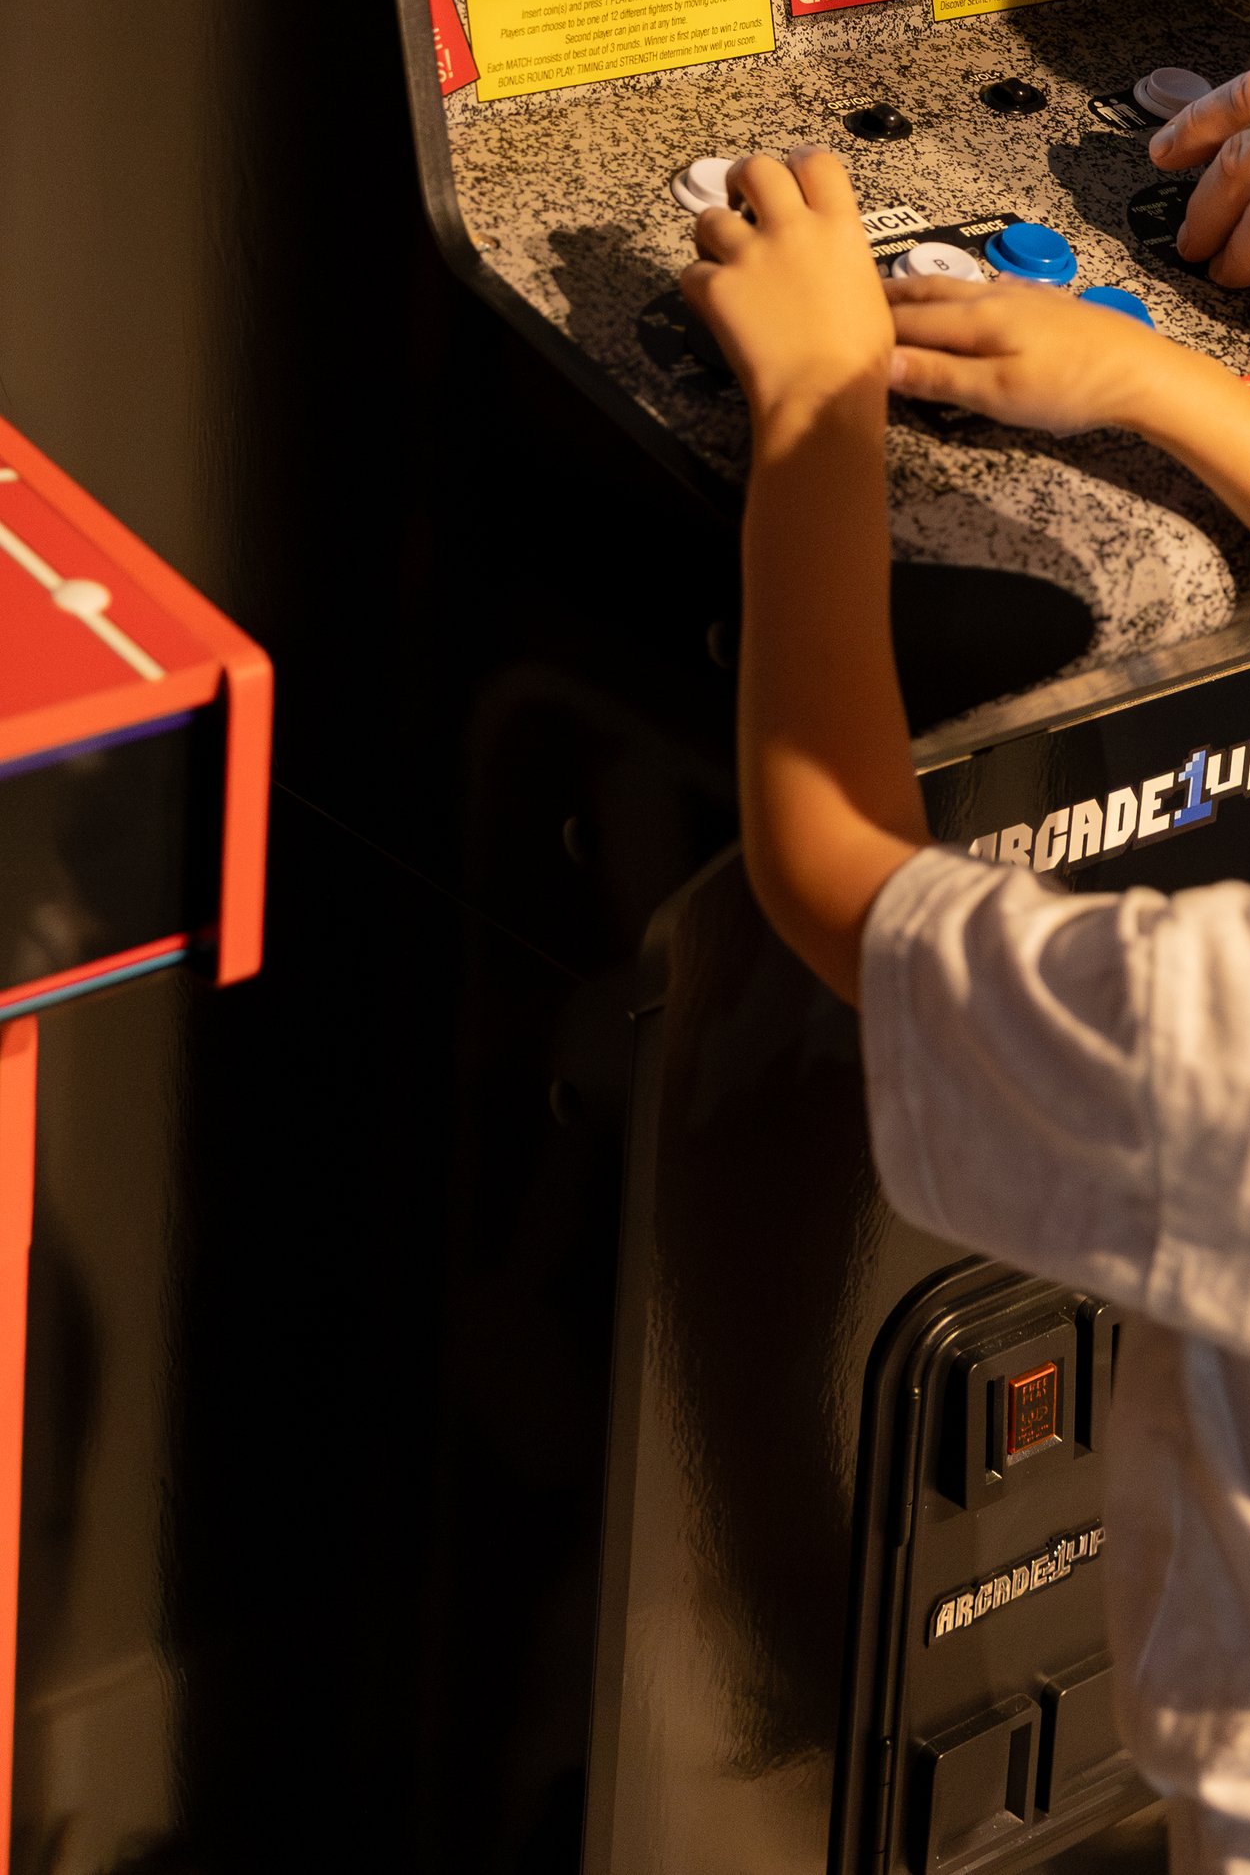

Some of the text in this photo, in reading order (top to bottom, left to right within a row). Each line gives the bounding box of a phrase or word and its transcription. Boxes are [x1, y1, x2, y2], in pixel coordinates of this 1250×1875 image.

[500, 25, 525, 41] Players
[526, 25, 539, 35] can
[541, 19, 565, 32] choose
[567, 18, 575, 28] to
[576, 16, 585, 26] be
[586, 15, 600, 25] one
[601, 12, 608, 22] of
[610, 10, 619, 20] 12
[619, 5, 646, 19] different
[648, 1, 673, 16] fighters
[673, 0, 682, 11] by
[521, 6, 542, 19] Insert
[542, 2, 567, 18] coin(s)
[568, 0, 582, 12] and
[564, 30, 591, 44] Second
[591, 27, 613, 41] player
[614, 26, 627, 36] can
[627, 22, 641, 35] join
[649, 20, 656, 29] at
[657, 19, 669, 30] any
[671, 14, 687, 26] time.
[486, 60, 503, 73] Each
[504, 56, 531, 70] MATCH
[533, 51, 563, 65] consists
[563, 49, 571, 60] of
[572, 47, 587, 59] best
[588, 45, 600, 56] out
[601, 43, 609, 54] of
[616, 38, 640, 51] rounds.
[644, 33, 668, 46] Winner
[676, 29, 689, 40] first
[690, 26, 710, 40] player
[711, 24, 718, 34] to
[719, 22, 731, 33] win
[497, 73, 526, 88] BONUS
[526, 68, 555, 83] ROUND
[576, 59, 604, 74] TIMING
[604, 58, 618, 69] and
[618, 50, 657, 67] STRENGTH
[658, 45, 692, 60] determine
[693, 42, 707, 54] how
[709, 39, 722, 51] well
[723, 38, 735, 50] you
[827, 96, 873, 111] OFF/ON
[959, 219, 1009, 238] FIERCE
[933, 258, 950, 271] B
